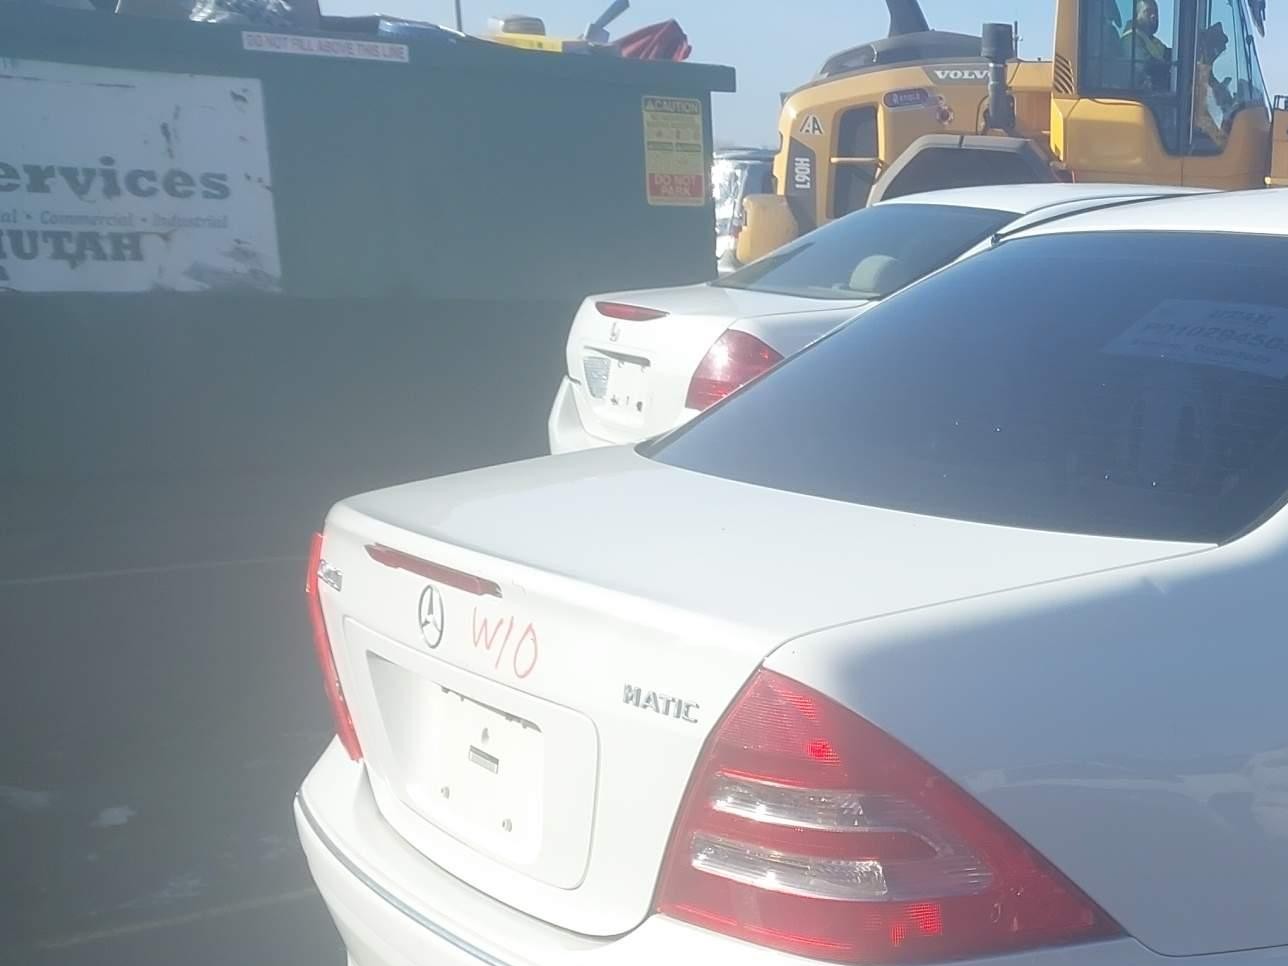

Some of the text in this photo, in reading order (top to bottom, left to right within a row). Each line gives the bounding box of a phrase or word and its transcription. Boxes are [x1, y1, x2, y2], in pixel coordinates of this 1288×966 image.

[935, 70, 990, 80] VOLV
[655, 100, 698, 113] CAUTION
[795, 157, 811, 189] L90H
[39, 210, 134, 226] Commercial
[152, 213, 228, 229] Industrial
